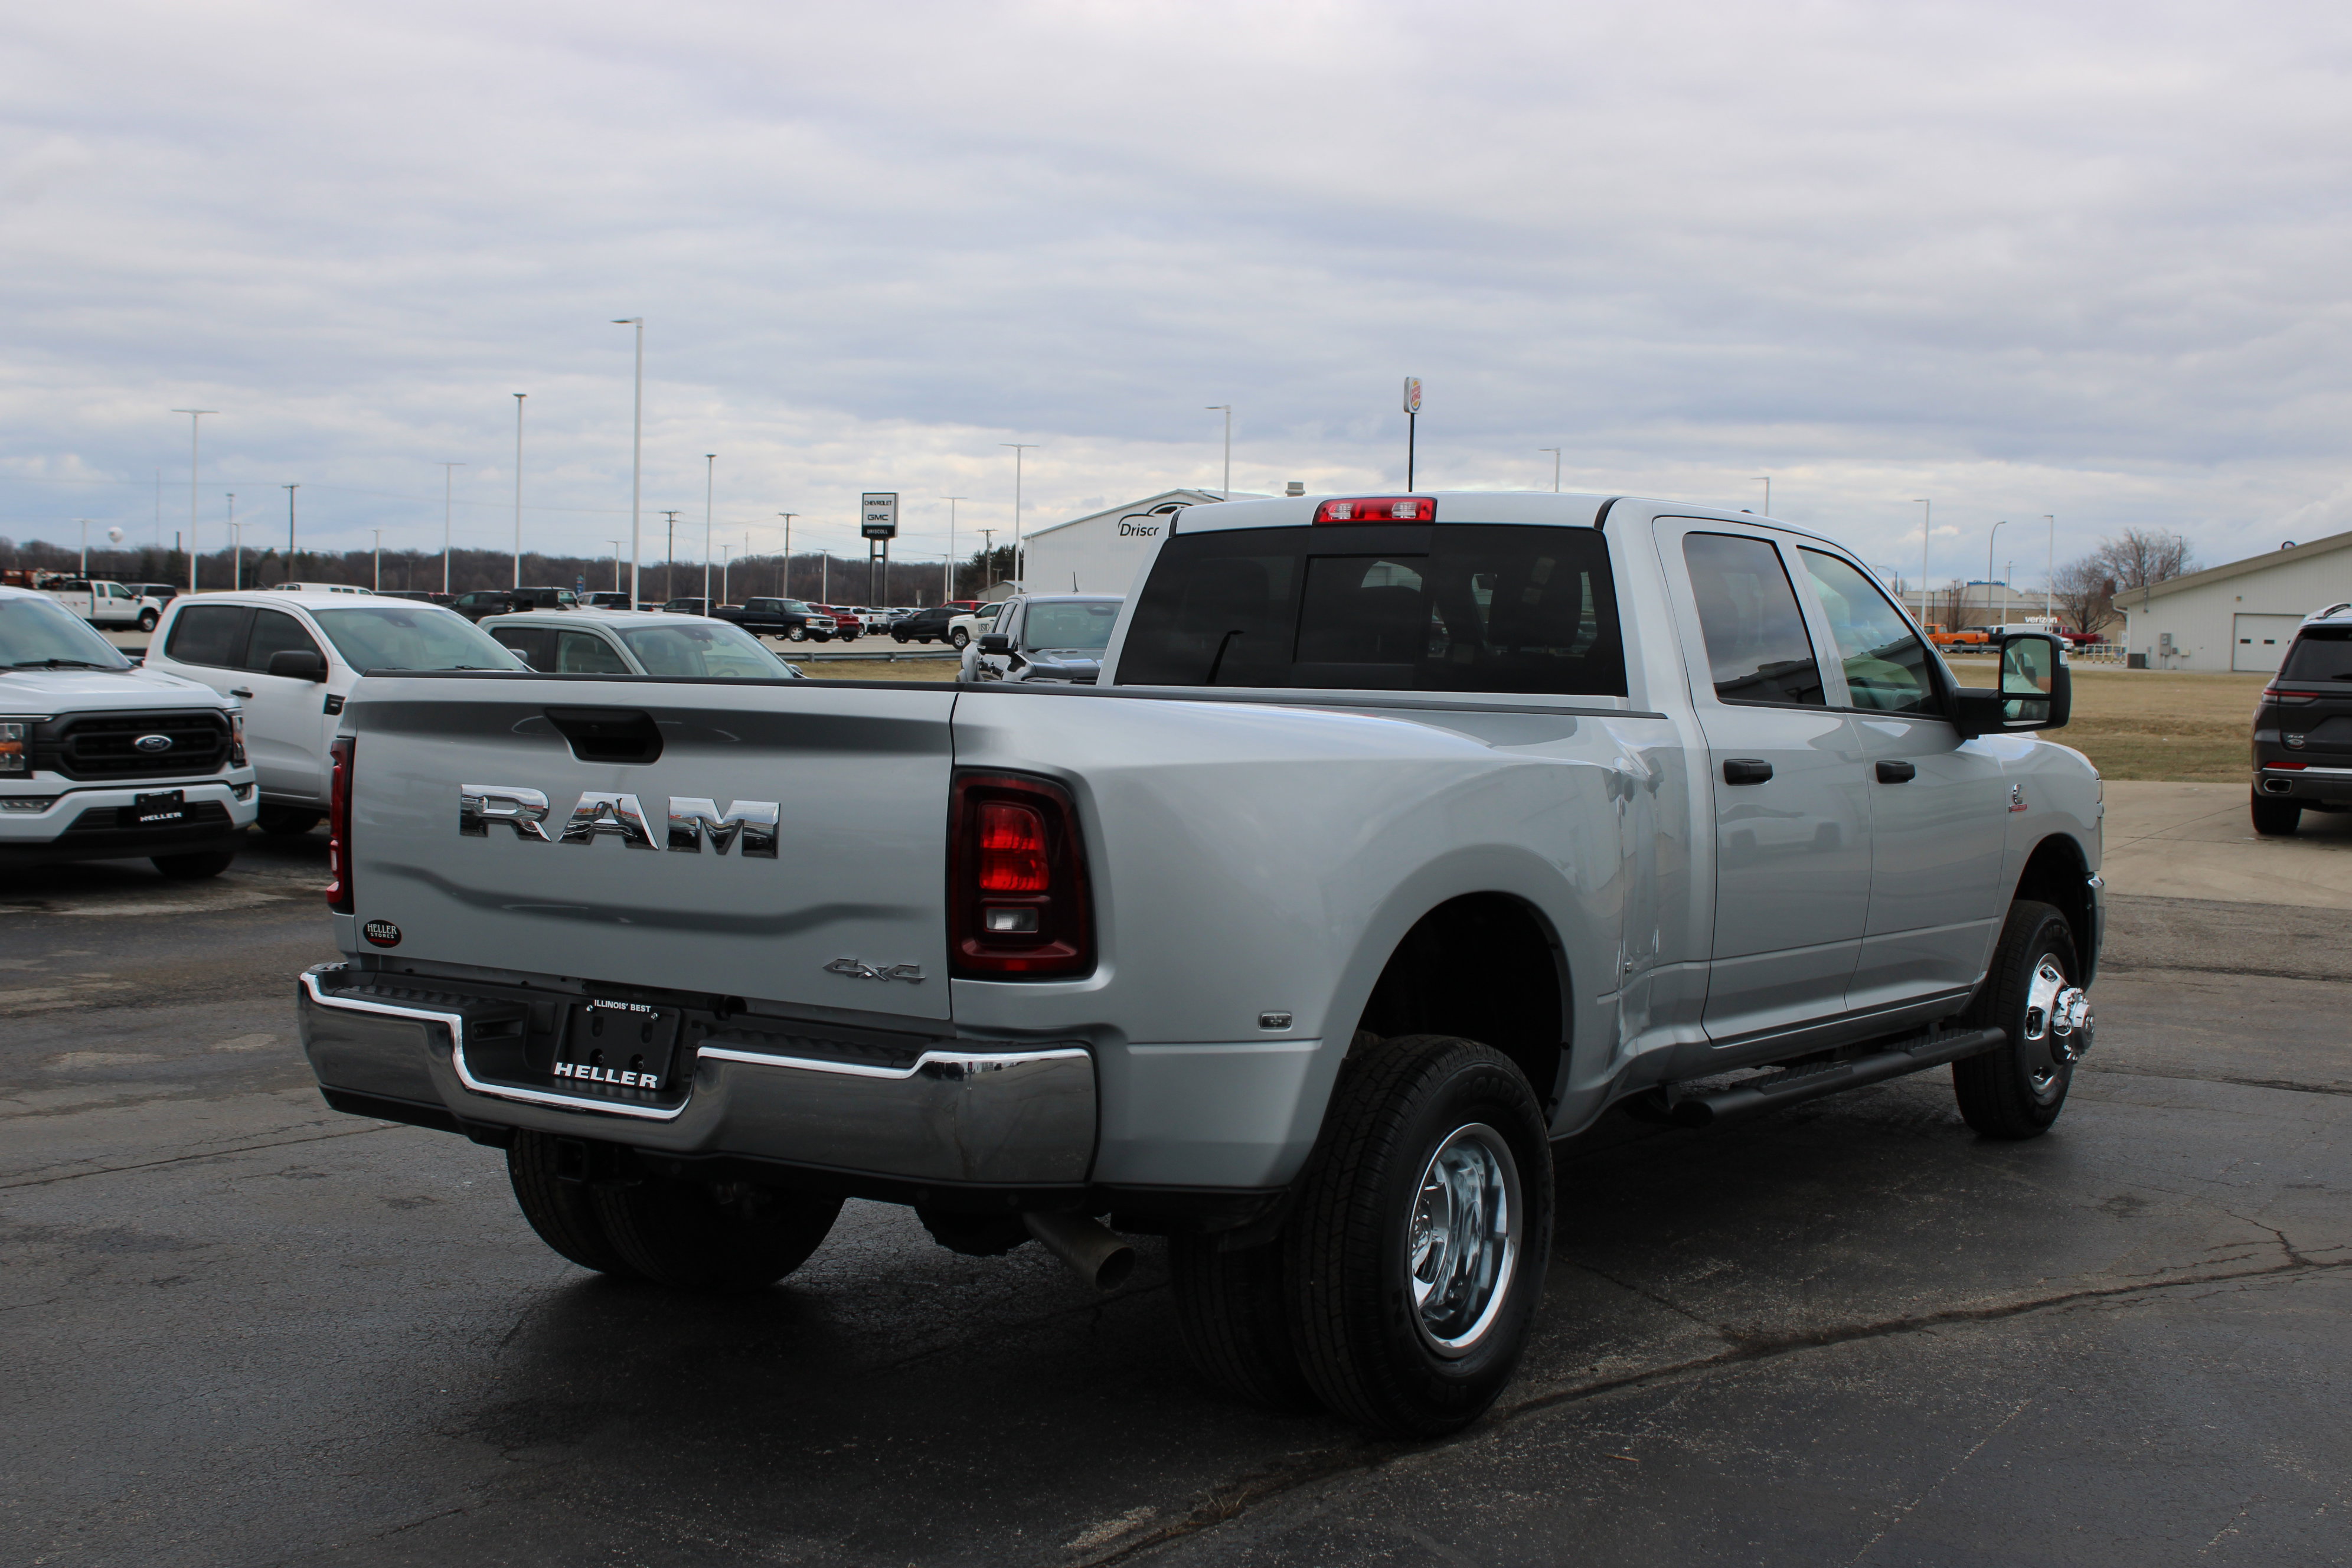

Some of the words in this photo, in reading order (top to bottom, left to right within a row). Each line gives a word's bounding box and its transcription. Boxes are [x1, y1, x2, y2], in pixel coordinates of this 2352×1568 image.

[140, 812, 182, 822] HELLER
[459, 783, 780, 859] RAM
[367, 923, 397, 935] HELLER
[630, 1004, 651, 1012] BEST
[554, 1062, 658, 1089] HELLER
